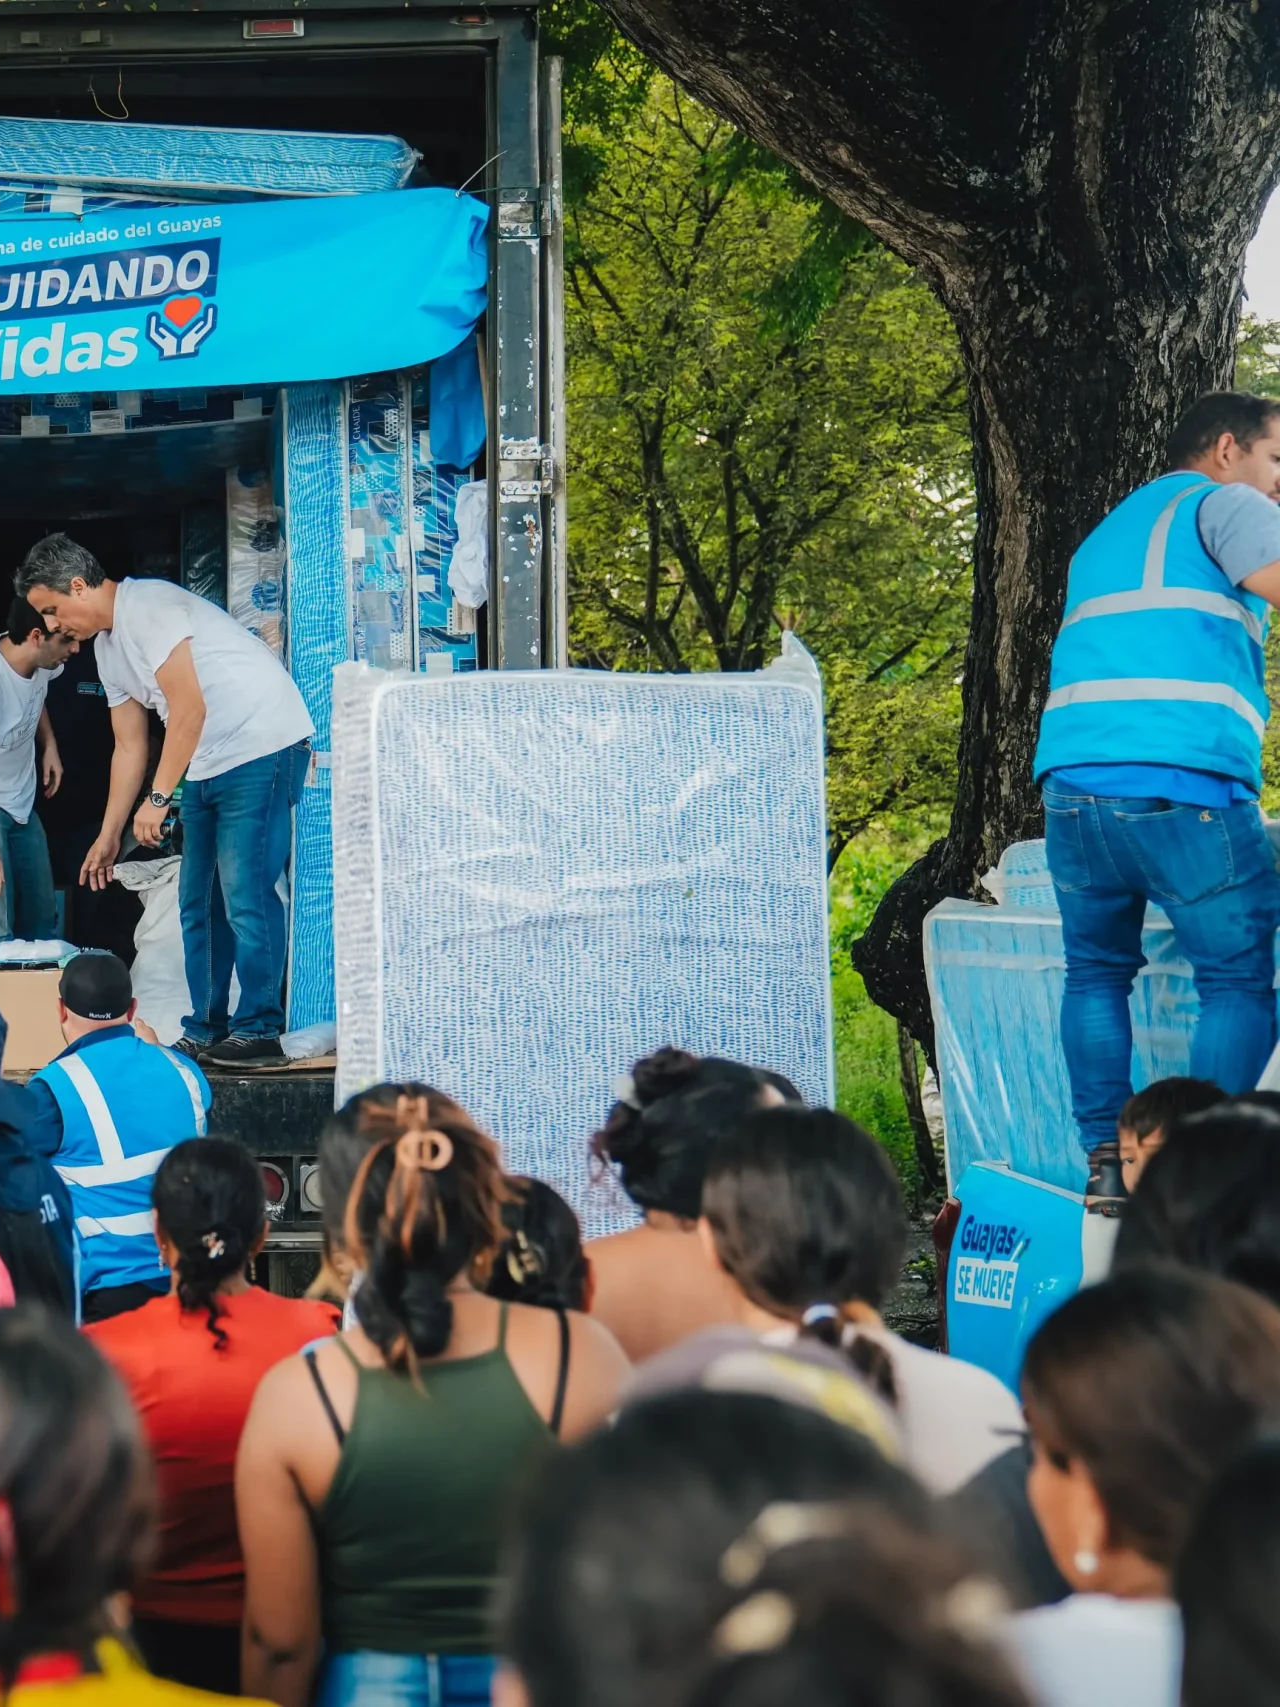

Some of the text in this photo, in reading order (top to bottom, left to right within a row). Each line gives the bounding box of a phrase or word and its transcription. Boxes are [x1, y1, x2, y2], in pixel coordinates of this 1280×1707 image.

[21, 237, 43, 252] de
[49, 228, 119, 250] cuidado
[125, 223, 152, 238] del
[157, 215, 222, 236] Guayas
[353, 404, 361, 440] CHAIDE
[960, 1214, 1018, 1264] Guayas
[957, 1264, 1015, 1302] SE MUEVE
